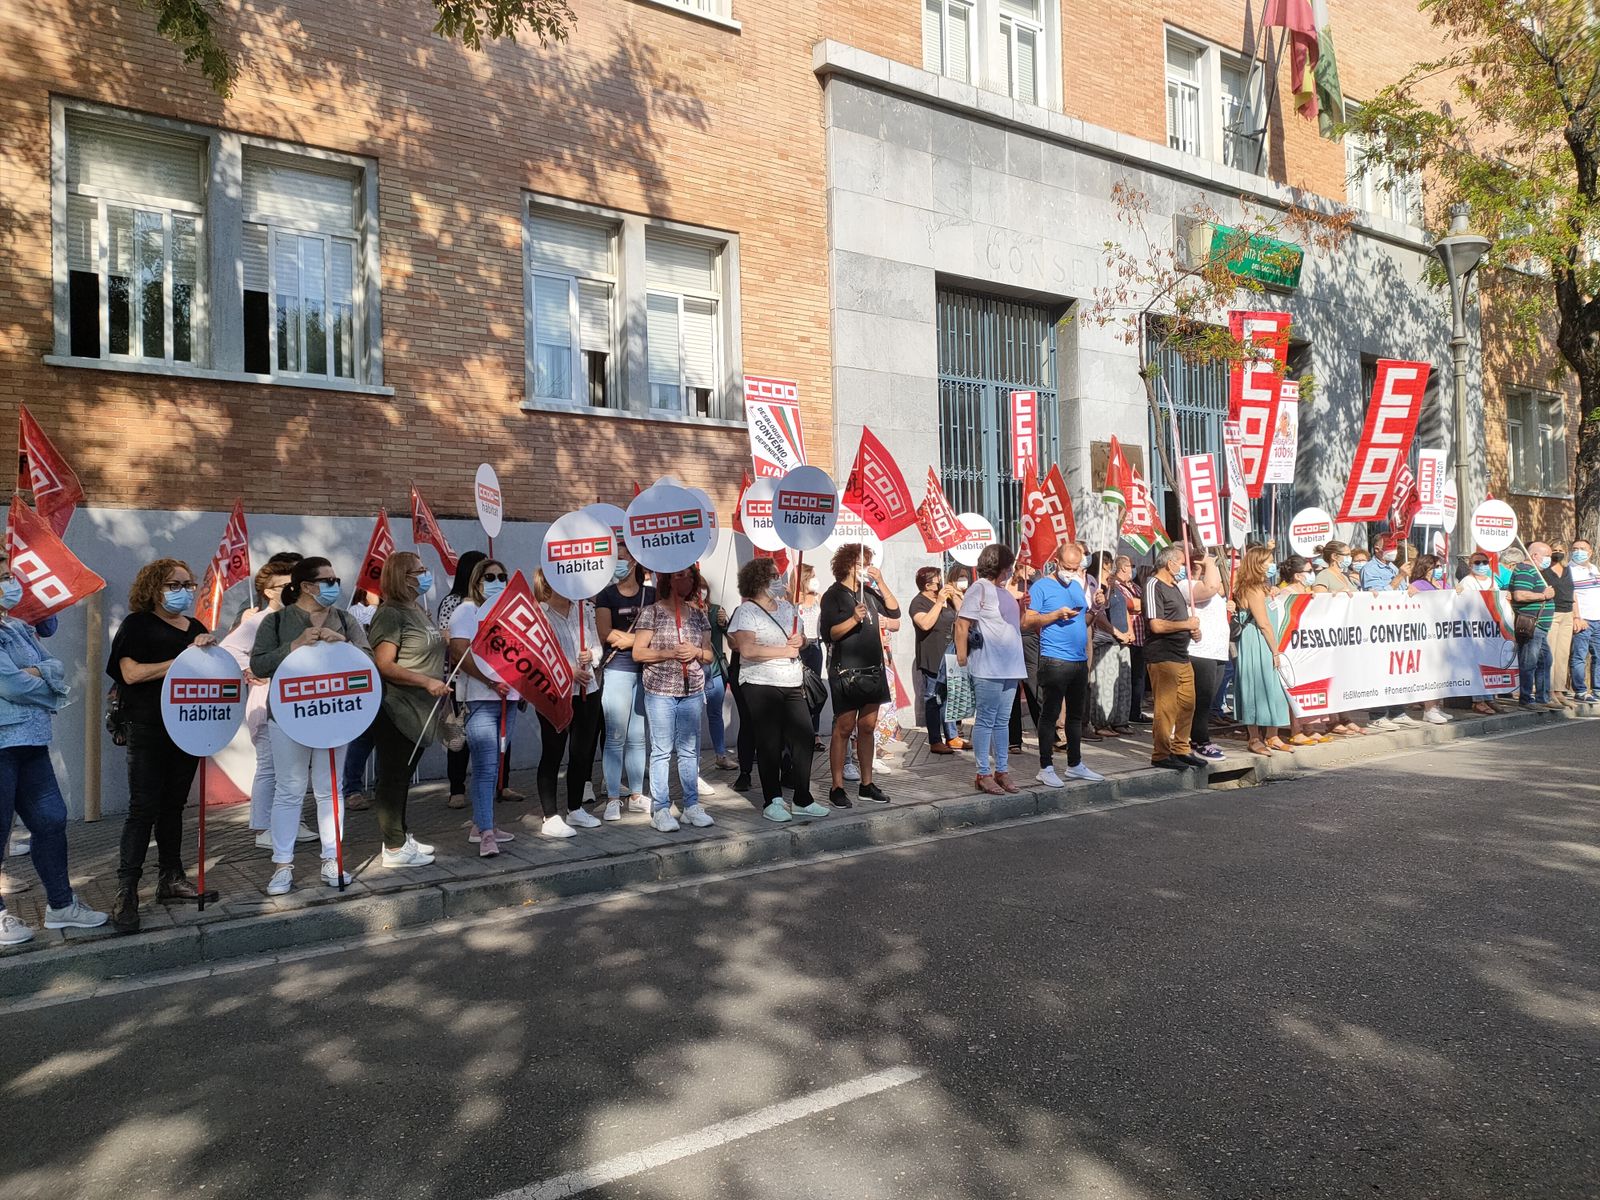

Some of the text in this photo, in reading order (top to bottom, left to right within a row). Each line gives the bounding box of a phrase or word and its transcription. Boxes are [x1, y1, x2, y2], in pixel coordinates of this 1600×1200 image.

[745, 381, 798, 401] CCOO
[1239, 319, 1278, 485] CCOO
[755, 419, 788, 458] CONVENIO
[1347, 367, 1418, 517] CCOO
[749, 504, 772, 514] CCO
[781, 495, 818, 508] CCOO
[1189, 456, 1218, 547] CCOO
[632, 517, 680, 532] CCOO
[784, 511, 826, 526] hábitat
[641, 530, 695, 549] hábitat
[551, 543, 592, 558] CCOO
[557, 558, 604, 575] hábitat
[1291, 626, 1362, 649] DESBLOQUEO
[1370, 622, 1427, 643] CONVENIO
[508, 604, 567, 688] CCOO
[483, 624, 558, 705] fecoma
[173, 684, 220, 698] CCOO
[283, 677, 345, 699] CCOO
[179, 705, 231, 722] hábitat
[293, 696, 363, 719] hábitat
